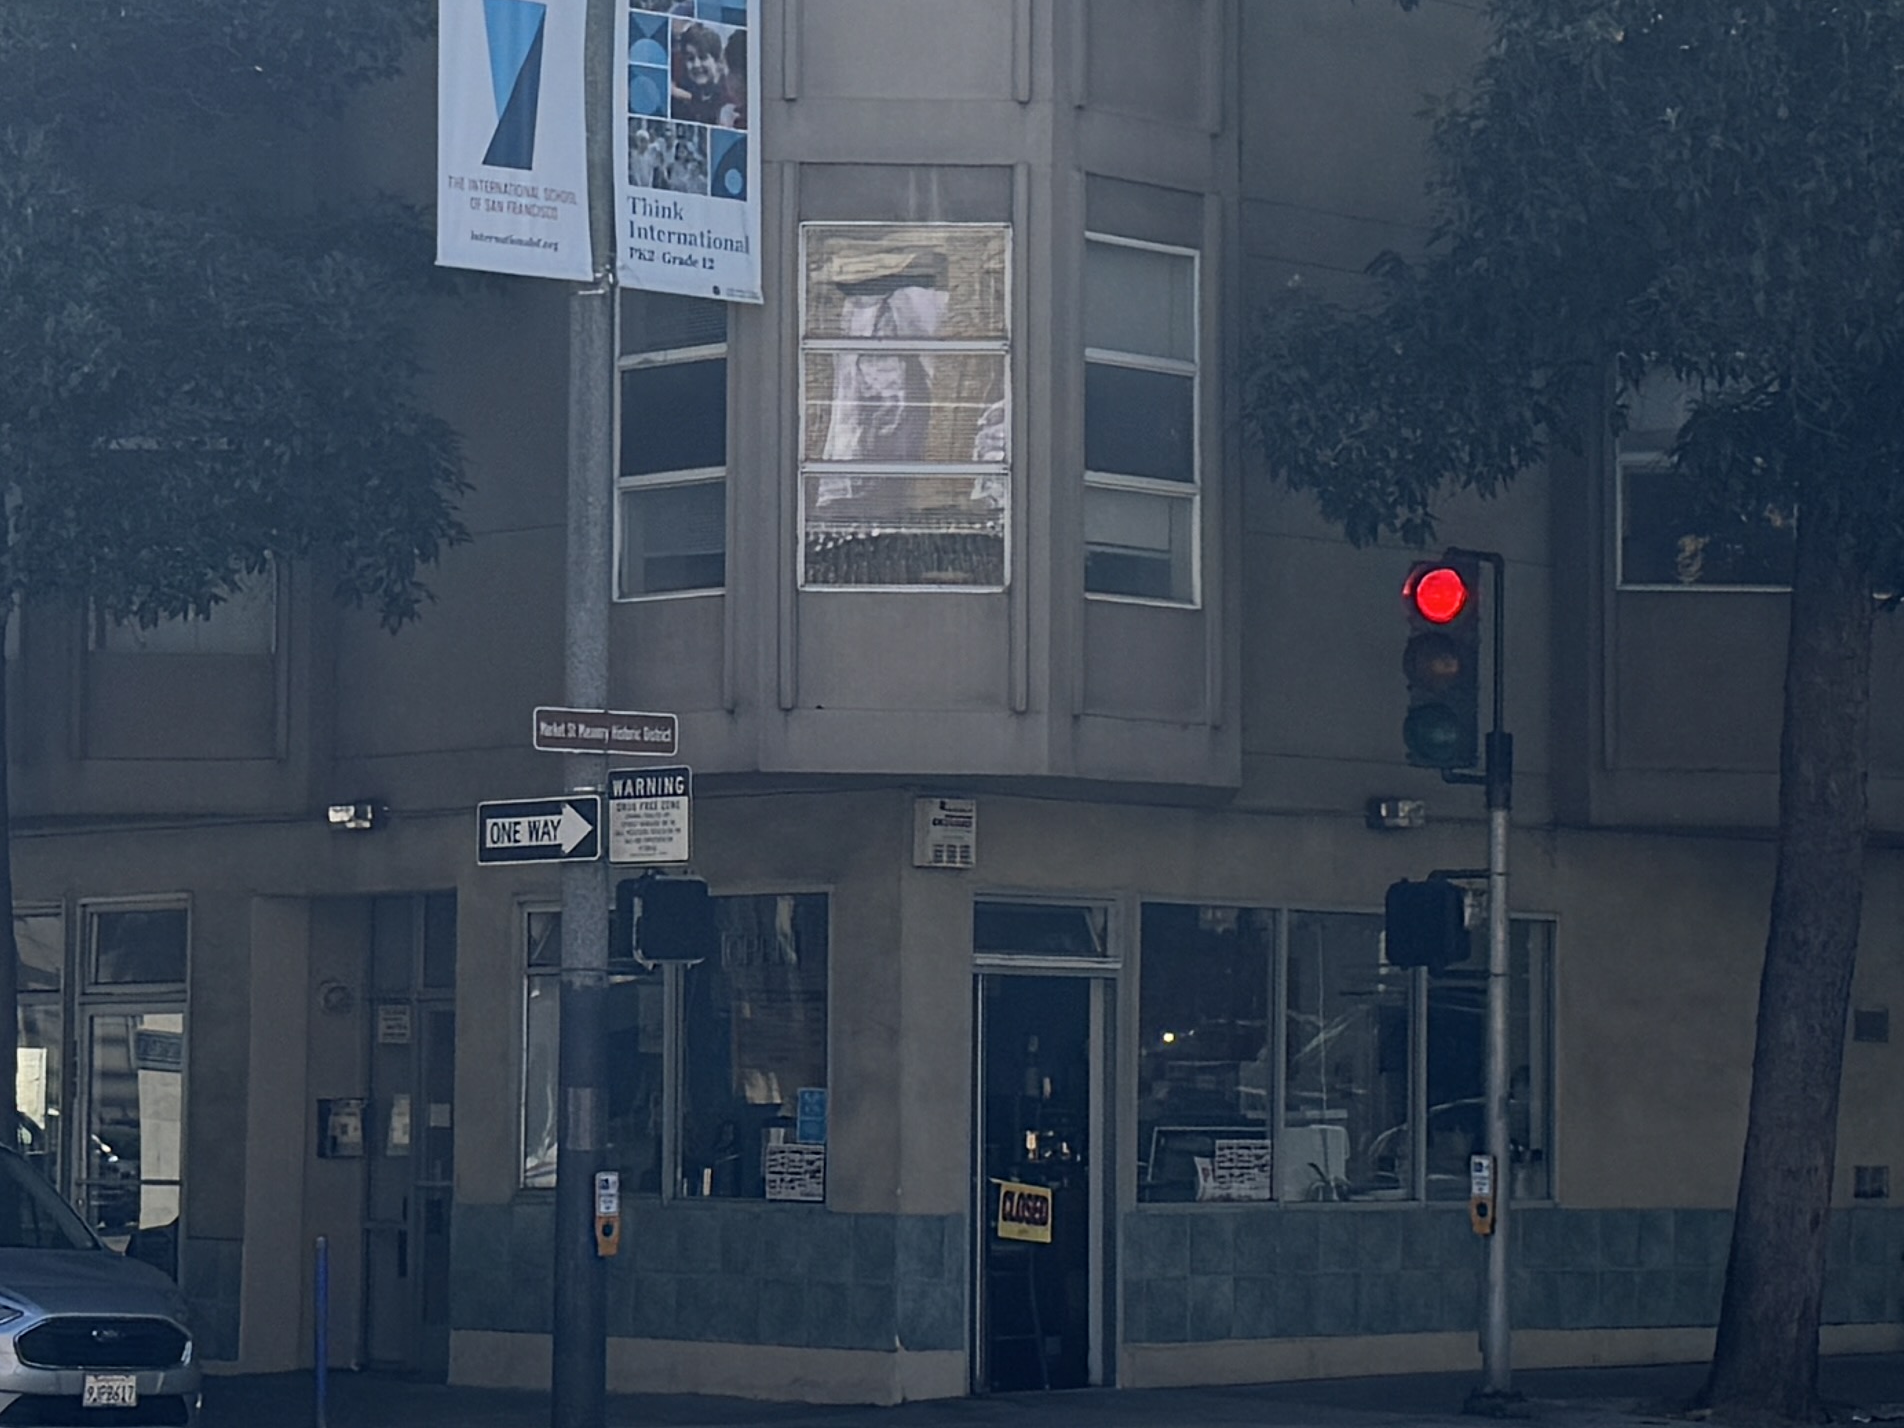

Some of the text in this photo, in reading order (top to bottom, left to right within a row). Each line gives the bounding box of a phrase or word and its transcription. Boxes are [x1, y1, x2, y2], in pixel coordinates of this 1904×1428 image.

[448, 175, 578, 205] THE INTERNATIONAL SCHOOL
[470, 196, 559, 221] OF SAN FRANCISCO
[627, 195, 684, 221] Think
[629, 220, 750, 255] International
[662, 252, 698, 269] Grade
[702, 256, 715, 270] 12
[611, 724, 642, 741] Historic
[643, 726, 672, 743] District
[612, 776, 685, 797] WARNING
[639, 800, 658, 811] FREE
[490, 818, 562, 845] ONE WAY
[1002, 1190, 1049, 1226] CLOSED
